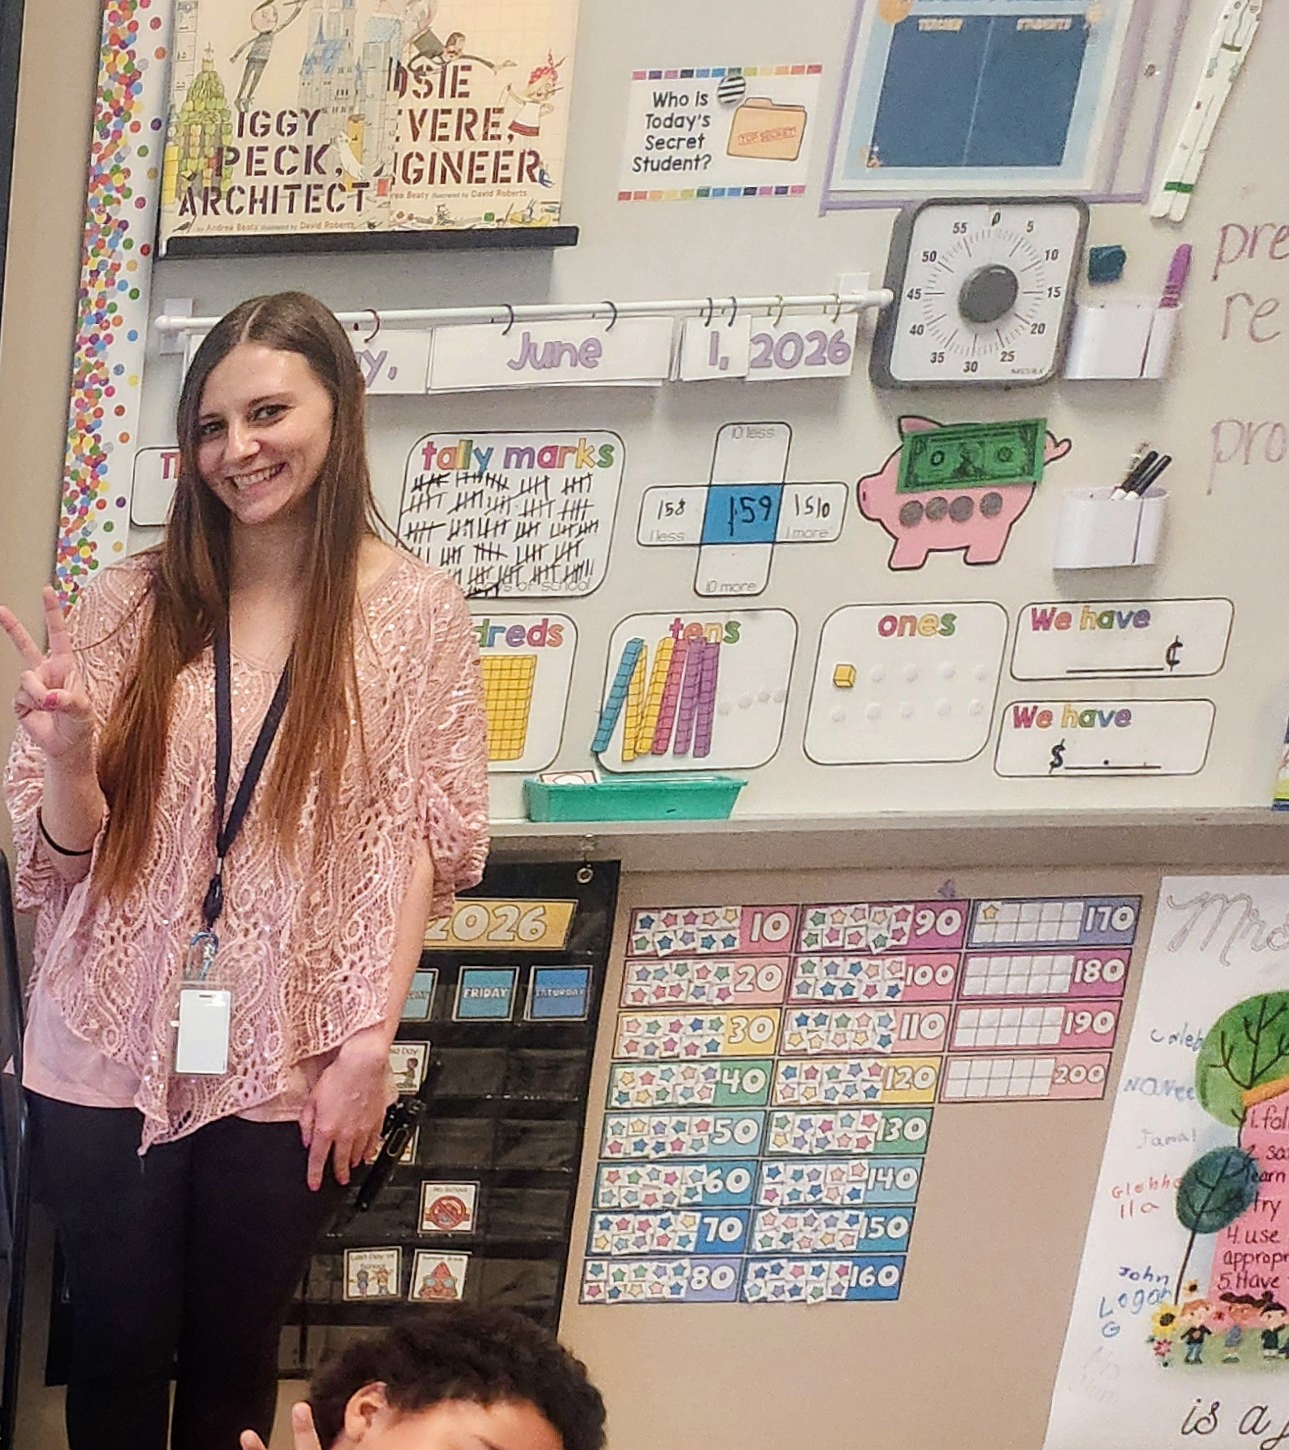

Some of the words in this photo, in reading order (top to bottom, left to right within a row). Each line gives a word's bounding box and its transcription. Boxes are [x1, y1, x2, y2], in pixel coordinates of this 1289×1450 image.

[653, 91, 689, 108] Who
[237, 109, 322, 138] IGGY
[645, 113, 711, 132] Today's
[645, 133, 705, 151] Secret
[214, 144, 343, 178] PECK,
[390, 149, 540, 186] GINEER
[632, 154, 713, 173] Student?
[178, 182, 370, 216] ARCHITECT
[471, 188, 493, 199] David
[494, 187, 528, 199] Roberts
[206, 221, 236, 232] Andrea
[300, 220, 322, 230] David
[324, 220, 355, 230] Roberts
[953, 222, 968, 234] 55
[1026, 221, 1034, 233] 5
[921, 250, 937, 263] 50
[1045, 248, 1060, 261] 10
[907, 288, 921, 300] 45
[1047, 286, 1062, 298] 15
[909, 324, 924, 336] 40
[1030, 323, 1046, 335] 20
[1222, 292, 1281, 343] re
[507, 332, 603, 370] June
[708, 332, 730, 371] 1,
[749, 330, 851, 369] 2026
[930, 351, 945, 364] 35
[1000, 350, 1015, 362] 25
[963, 361, 979, 373] 30
[746, 426, 775, 439] less
[421, 439, 493, 477] tally
[503, 438, 614, 469] marks
[1206, 419, 1287, 496] pro
[728, 496, 772, 537] 159
[721, 582, 757, 593] more
[670, 617, 741, 645] tens
[877, 611, 957, 638] ones
[1030, 606, 1071, 632] We
[1080, 604, 1151, 630] have
[473, 618, 564, 648] dreds
[1013, 705, 1053, 730] We
[1061, 703, 1132, 728] have
[750, 911, 791, 944] 10
[915, 908, 963, 937] 90
[1084, 905, 1136, 932] 170
[734, 964, 782, 993] 20
[905, 962, 955, 987] 100
[1073, 958, 1126, 984] 180
[462, 986, 510, 999] FRIDAY
[728, 1016, 775, 1045] 30
[898, 1013, 946, 1041] 110
[1064, 1010, 1117, 1036] 190
[722, 1067, 767, 1095] 40
[884, 1065, 938, 1092] 120
[1053, 1064, 1106, 1086] 200
[710, 1117, 759, 1147] 50
[876, 1116, 927, 1143] 130
[704, 1167, 751, 1195] 60
[867, 1166, 918, 1191] 140
[702, 1216, 744, 1244] 70
[859, 1216, 909, 1241] 150
[1245, 1229, 1281, 1245] use
[689, 1264, 736, 1292] 80
[849, 1263, 900, 1288] 160
[1236, 1271, 1281, 1290] Have
[1180, 1398, 1221, 1436] is
[1239, 1405, 1272, 1435] a
